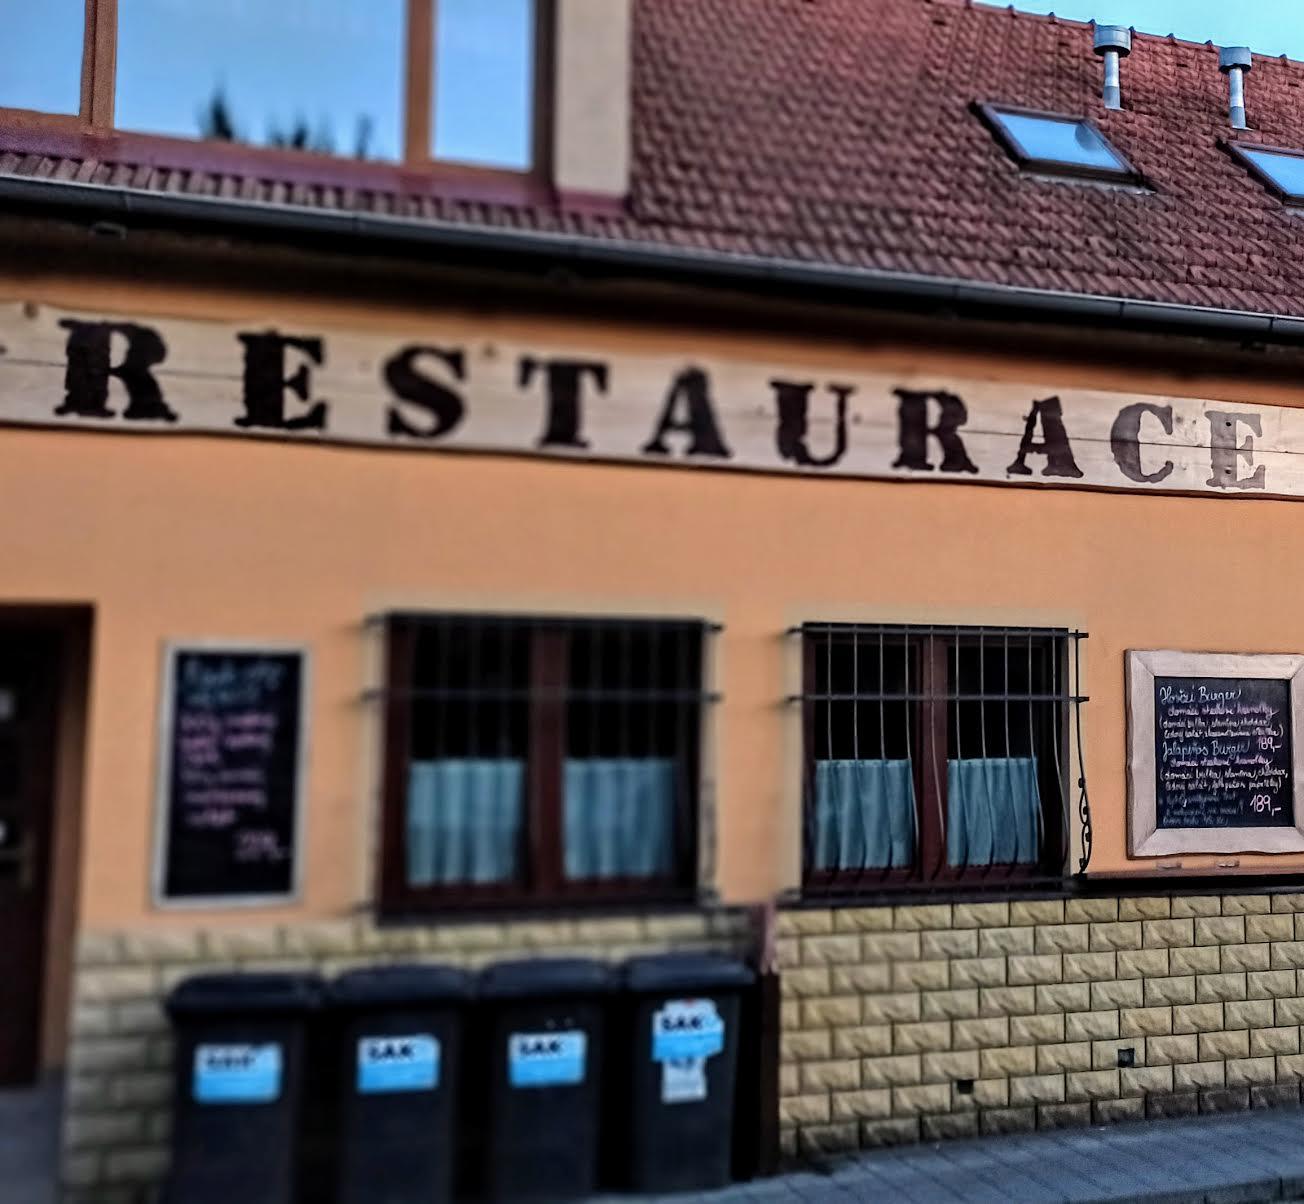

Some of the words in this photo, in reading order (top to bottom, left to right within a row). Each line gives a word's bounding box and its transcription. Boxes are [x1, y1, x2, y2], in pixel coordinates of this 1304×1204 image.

[54, 318, 1266, 490] RESTAURACE
[1198, 685, 1242, 709] Burger
[1211, 739, 1250, 760] Burger
[1249, 794, 1281, 816] 189,-
